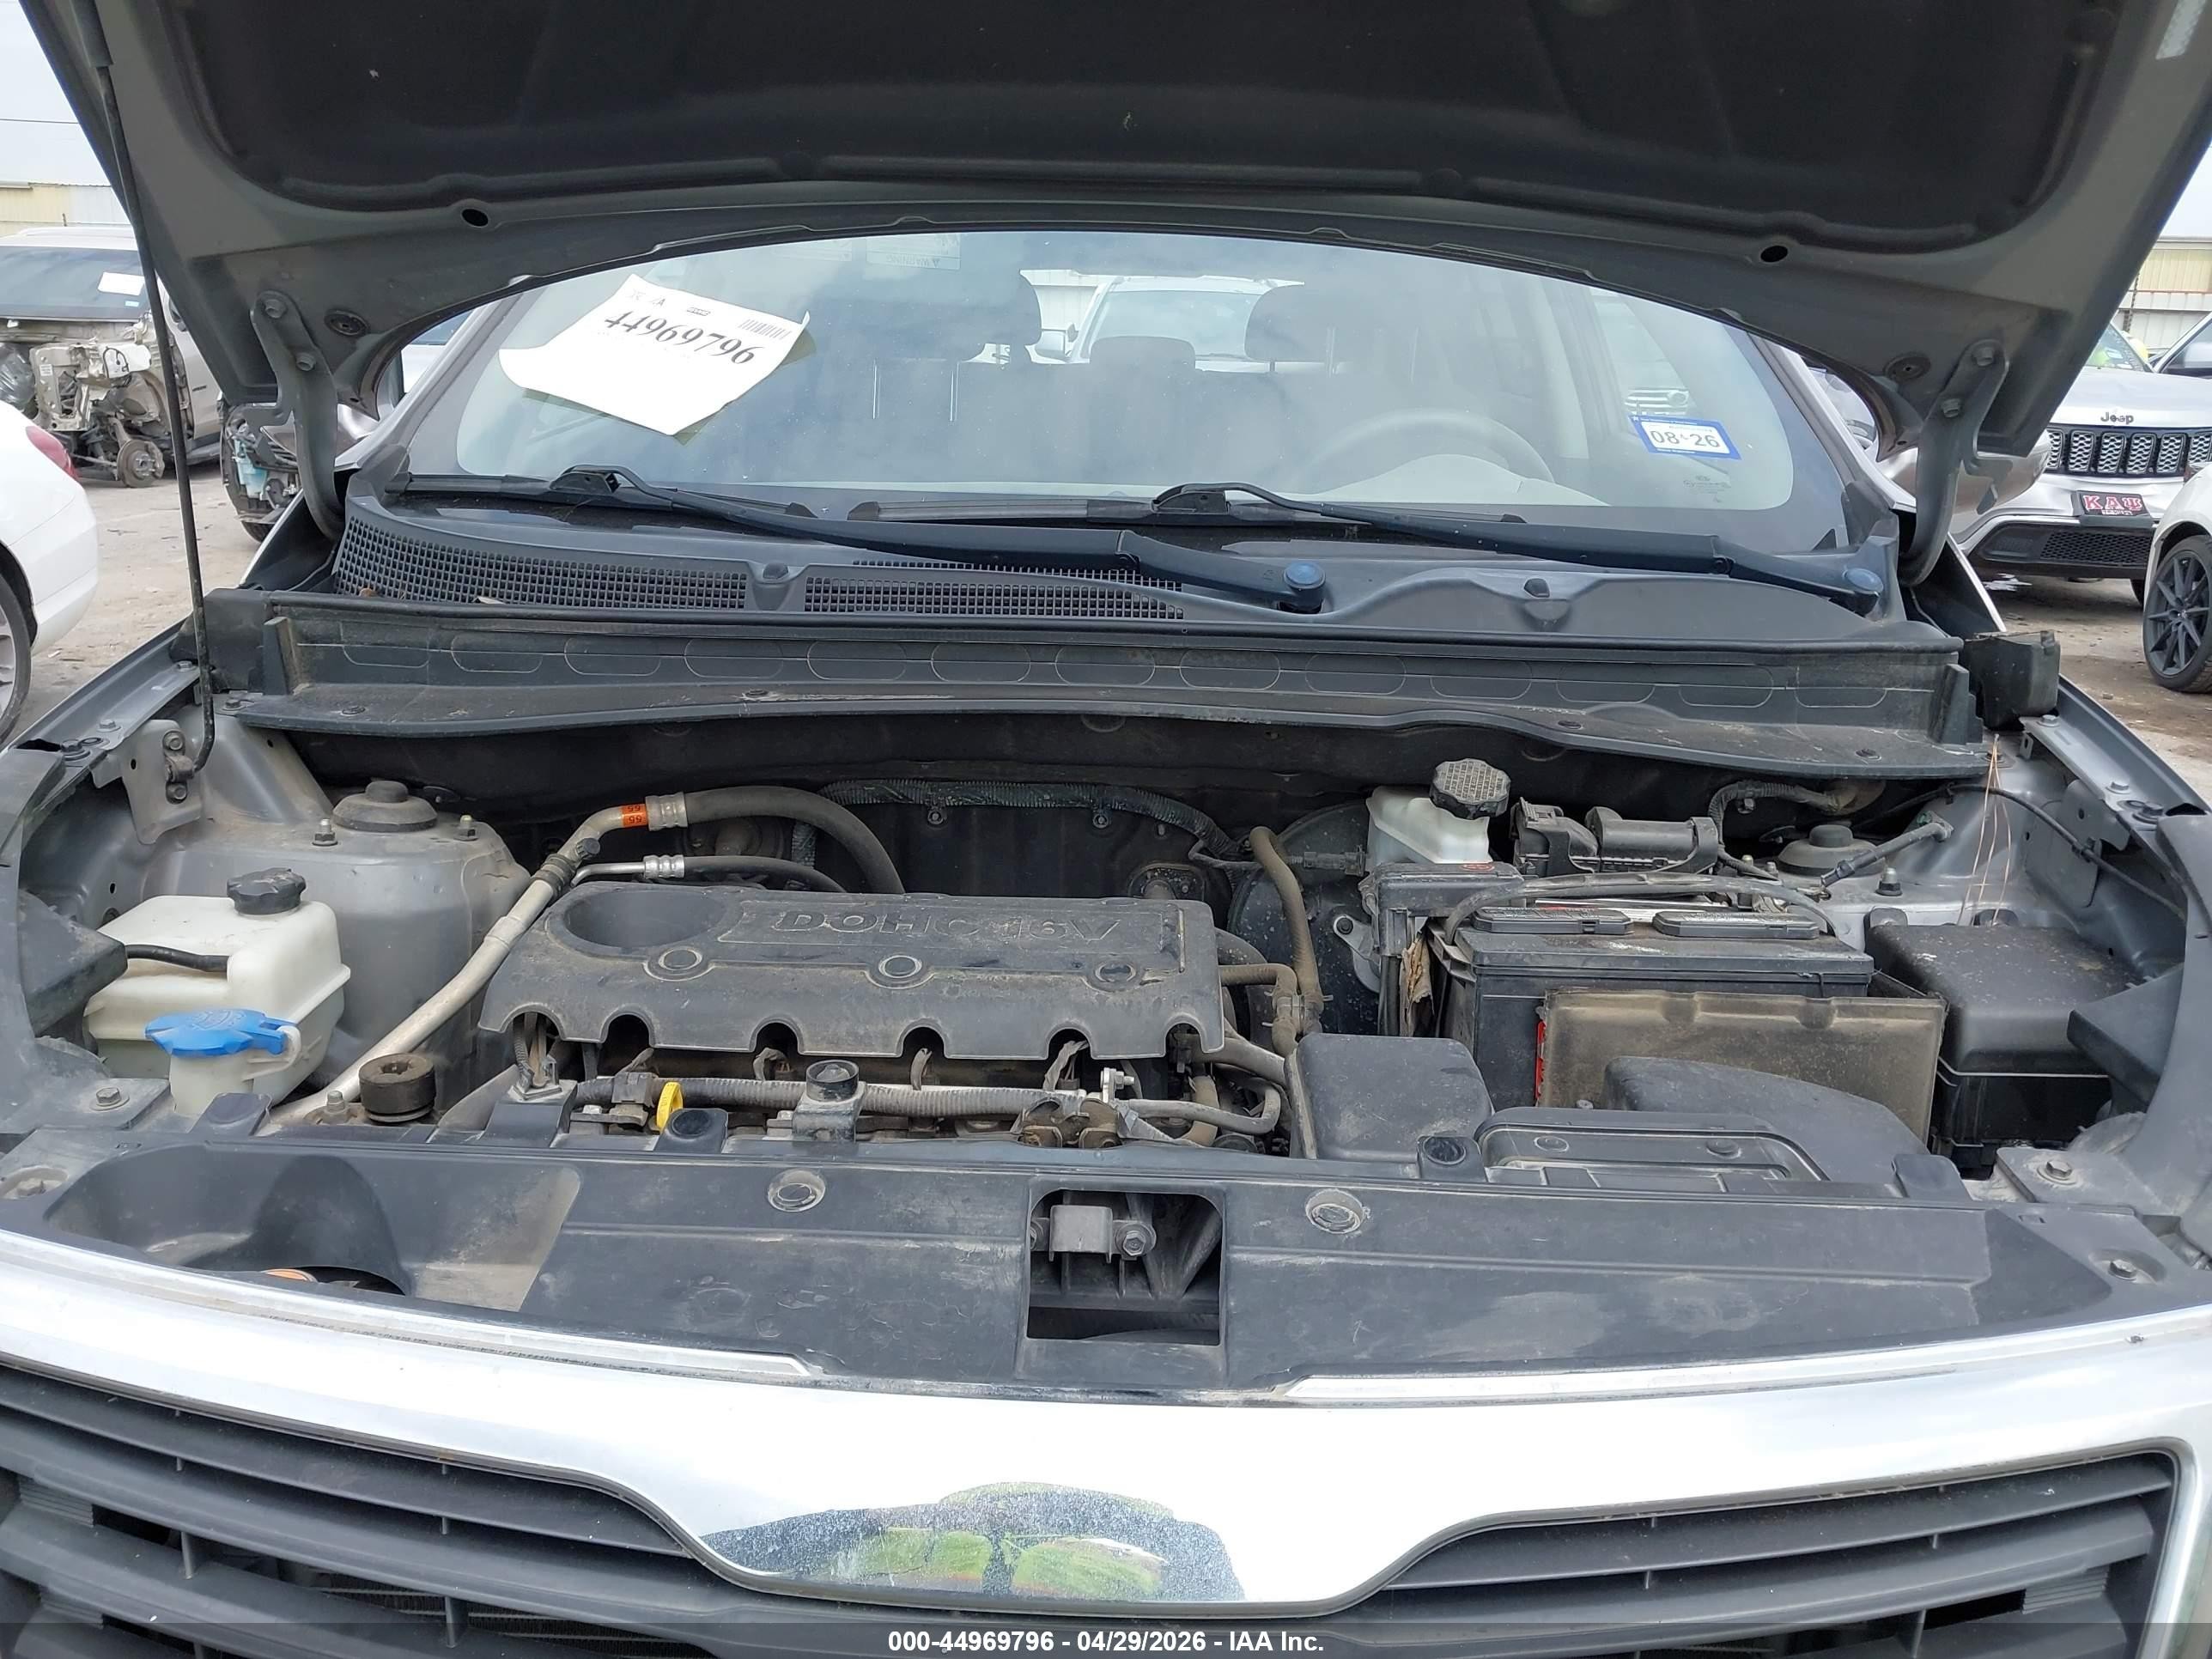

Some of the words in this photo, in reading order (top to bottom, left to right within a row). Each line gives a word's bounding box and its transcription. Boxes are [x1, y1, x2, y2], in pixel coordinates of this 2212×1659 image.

[604, 310, 765, 364] 44969796
[2100, 412, 2134, 424] Jeep
[1649, 430, 1680, 445] 08
[1689, 433, 1720, 448] 26
[772, 911, 981, 937] DOHC
